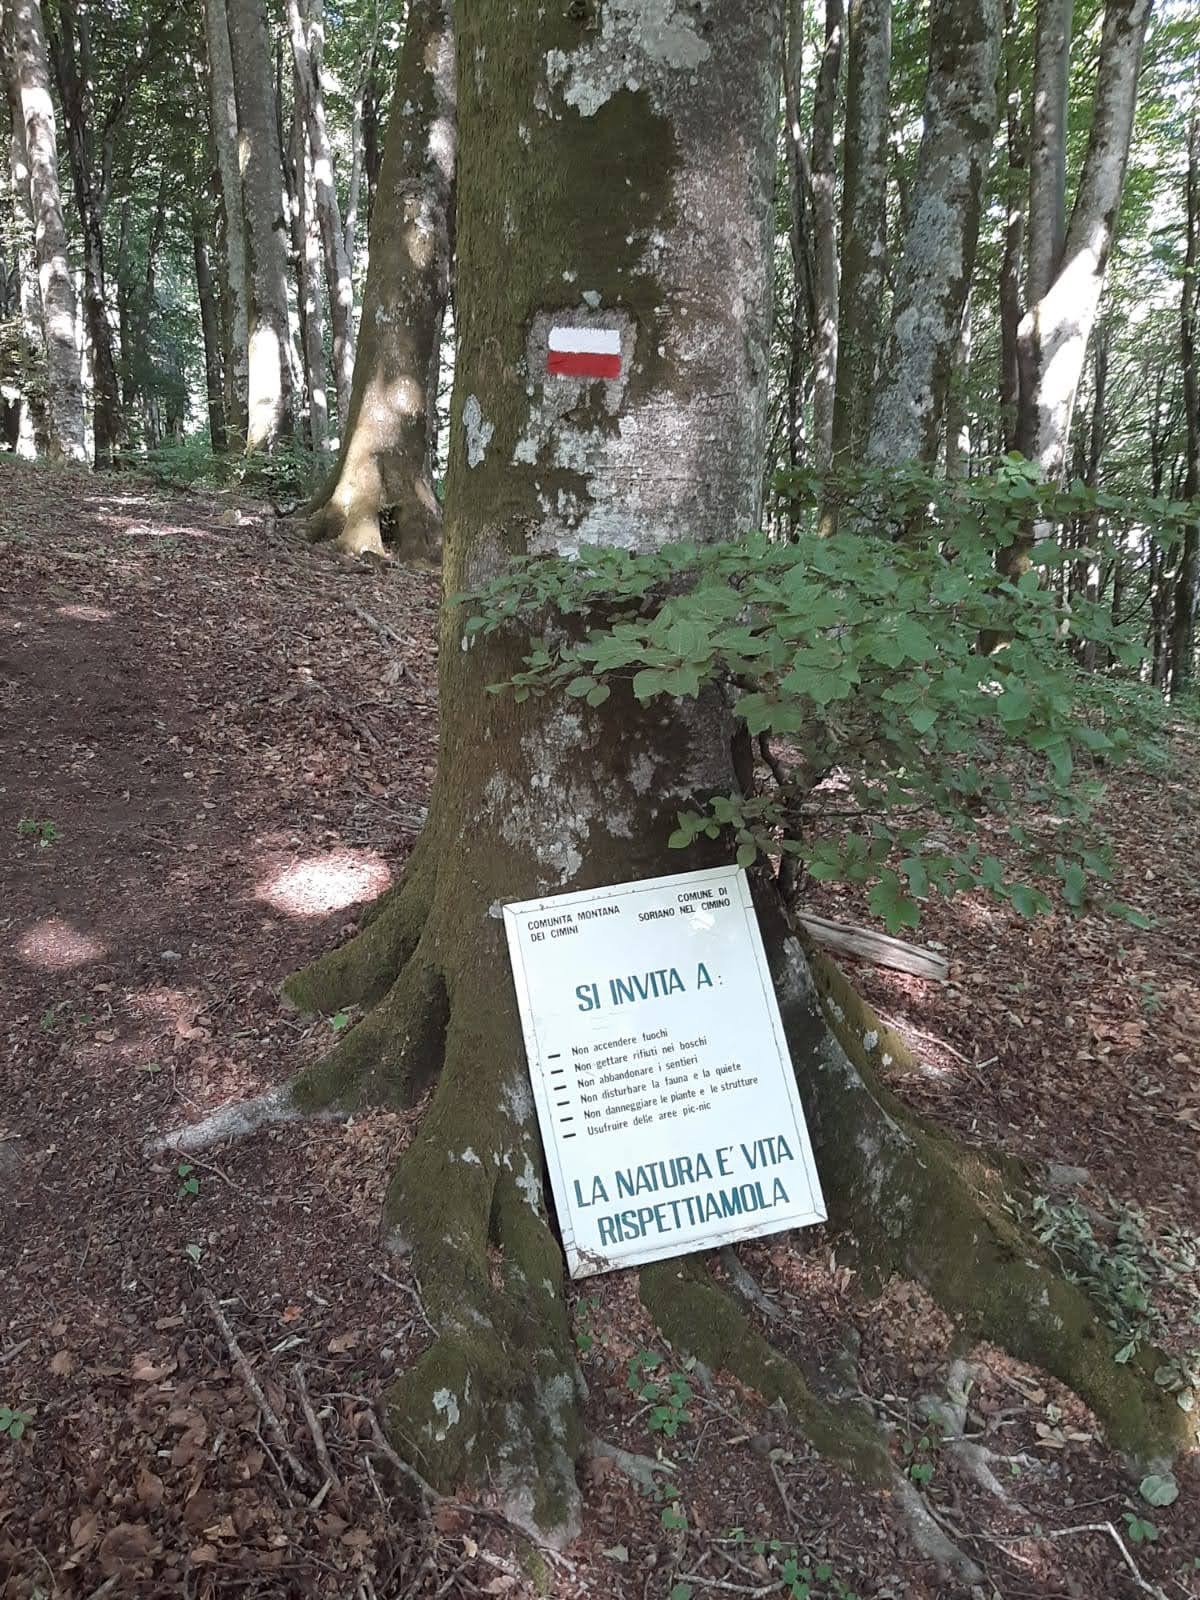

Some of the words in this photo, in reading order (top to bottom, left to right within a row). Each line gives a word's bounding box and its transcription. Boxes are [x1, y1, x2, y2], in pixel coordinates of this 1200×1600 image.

[638, 907, 675, 922] SORIANO
[679, 904, 696, 915] NEL
[701, 898, 730, 911] CIMINO
[677, 888, 713, 903] COMUNE
[718, 886, 728, 896] DI
[527, 914, 573, 931] COMUNITA
[577, 905, 620, 921] MONTANA
[530, 931, 545, 942] DEI
[550, 925, 579, 939] CIMINI
[575, 982, 601, 1012] SI
[608, 967, 686, 1006] INVITA
[572, 1045, 589, 1057] Non
[593, 1036, 637, 1052] accendere
[642, 1027, 668, 1042] fuochi
[574, 1062, 592, 1073] Non
[596, 1054, 628, 1070] gettare
[633, 1046, 658, 1060] rifiuti
[662, 1042, 675, 1054] nei
[680, 1035, 707, 1050] boschi
[577, 1078, 595, 1089] Non
[599, 1066, 654, 1084] abbandonare
[665, 1054, 698, 1070] sentieri
[580, 1094, 598, 1104] Non
[602, 1083, 647, 1100] disturbare
[651, 1079, 660, 1089] la
[665, 1074, 688, 1086] fauna
[702, 1068, 711, 1078] la
[716, 1062, 742, 1077] quiete
[583, 1109, 601, 1120] Non
[605, 1098, 658, 1116] danneggiare
[660, 1094, 668, 1103] le
[670, 1089, 696, 1103] piante
[710, 1084, 718, 1094] le
[721, 1077, 759, 1092] strutture
[587, 1119, 629, 1136] Usufruire
[659, 1109, 677, 1121] aree
[682, 1101, 712, 1117] pic-nic
[573, 1175, 610, 1208] LA
[615, 1153, 713, 1199] NATURA
[740, 1134, 795, 1170] VITA
[597, 1177, 790, 1247] RISPETTIAMOLA
